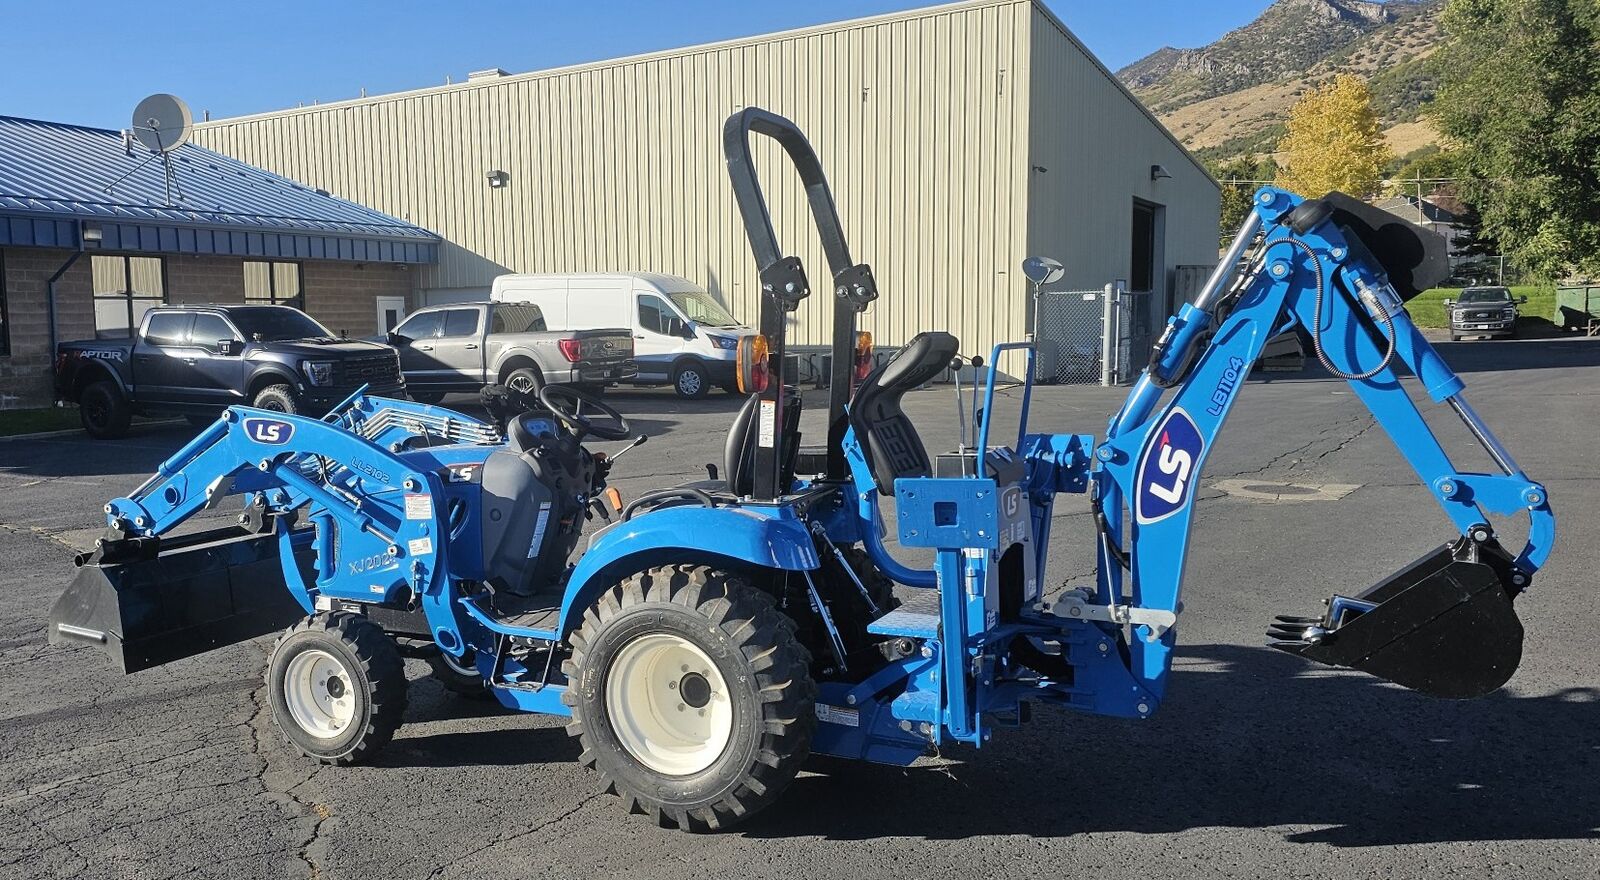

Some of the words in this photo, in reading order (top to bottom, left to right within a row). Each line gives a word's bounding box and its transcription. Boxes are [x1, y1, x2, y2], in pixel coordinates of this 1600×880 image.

[73, 350, 123, 363] RAPTOR
[1207, 356, 1245, 417] LB1104
[256, 424, 280, 441] LS
[351, 456, 391, 484] LL2102
[449, 467, 472, 483] LS
[1149, 444, 1192, 504] LS
[1007, 493, 1017, 516] LS
